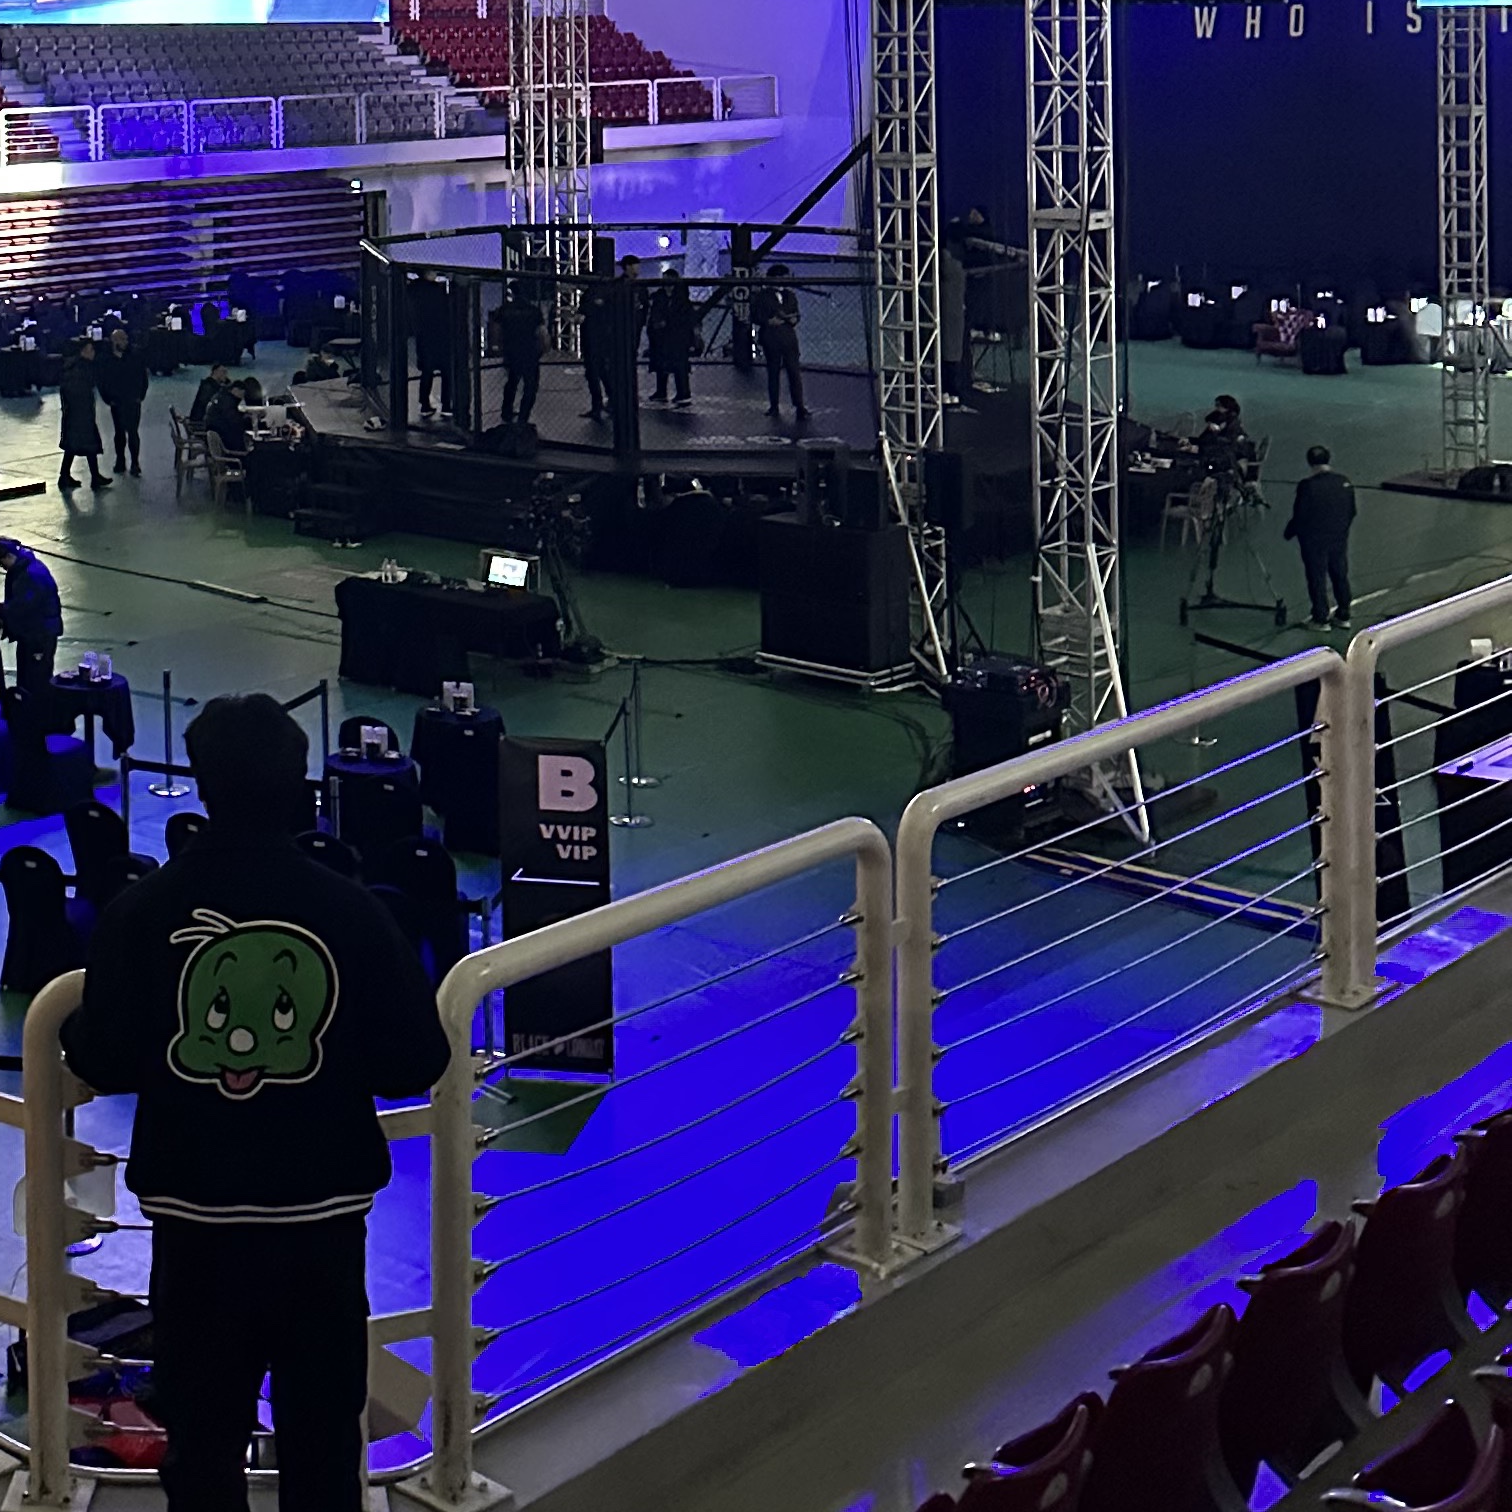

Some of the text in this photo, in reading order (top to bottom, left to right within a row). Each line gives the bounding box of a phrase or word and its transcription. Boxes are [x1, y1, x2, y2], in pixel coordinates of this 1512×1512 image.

[1194, 1, 1422, 38] WHO IS
[539, 754, 598, 812] B
[540, 824, 596, 840] VVIP
[557, 844, 597, 860] VIP
